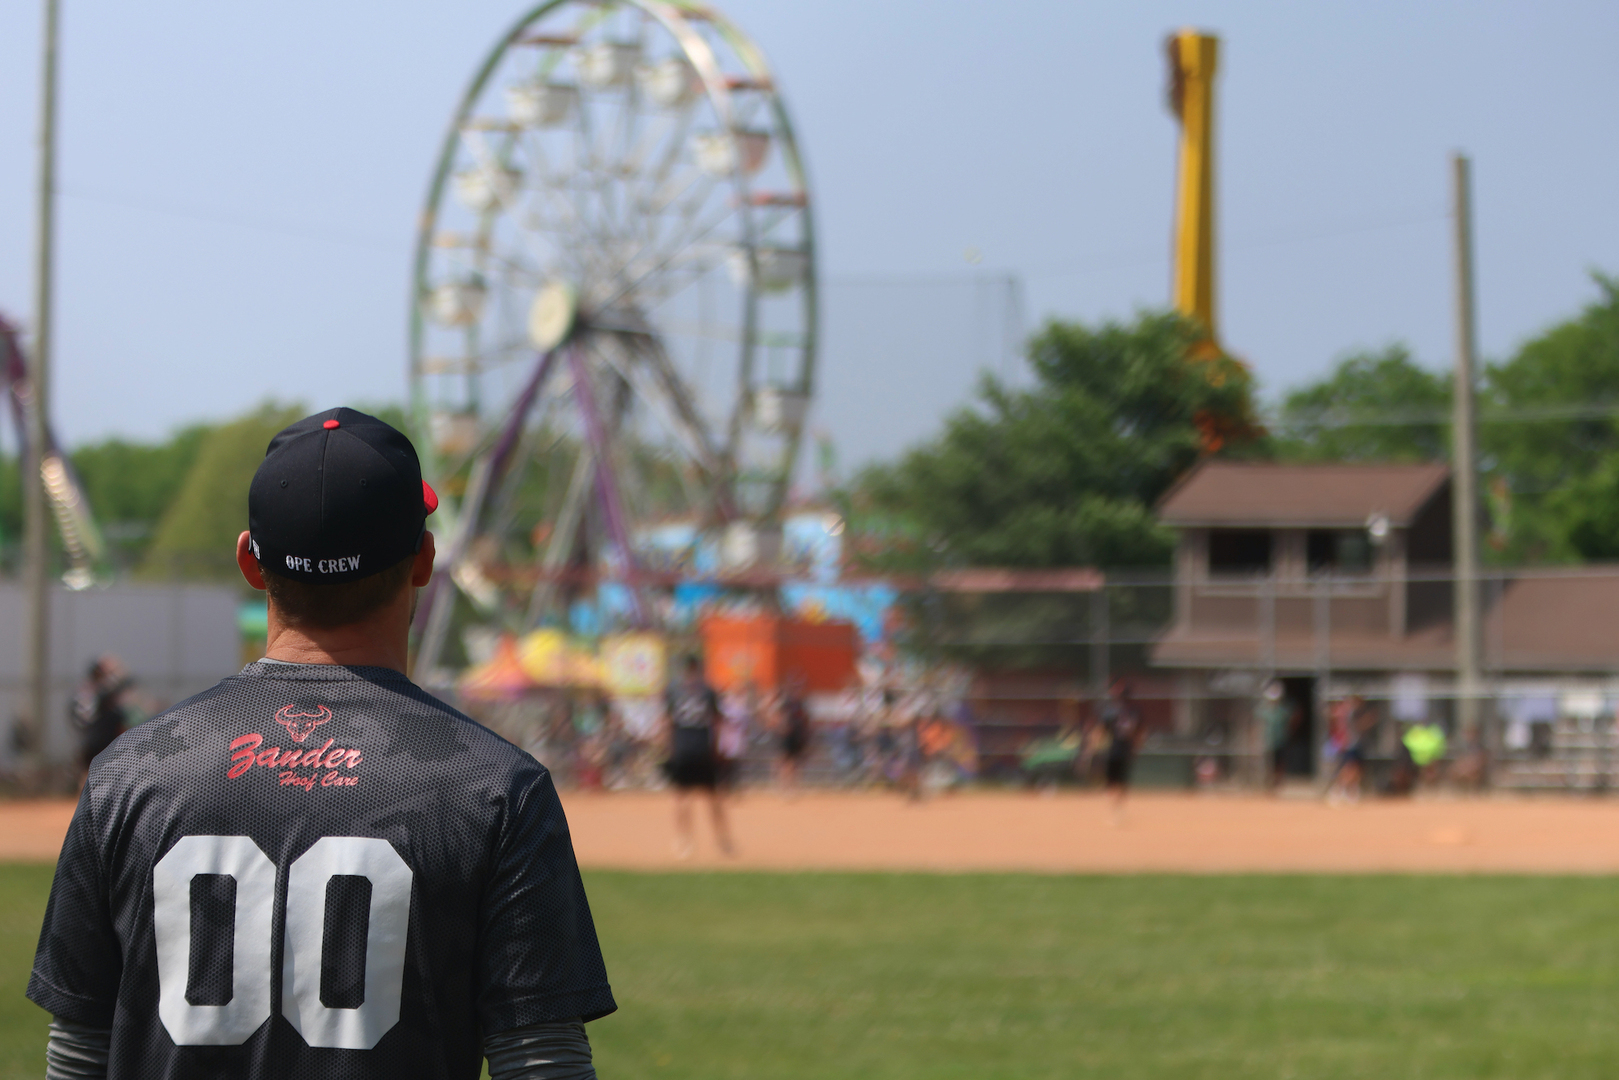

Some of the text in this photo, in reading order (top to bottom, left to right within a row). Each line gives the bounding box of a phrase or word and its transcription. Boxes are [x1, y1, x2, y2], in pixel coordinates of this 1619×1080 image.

[285, 554, 361, 573] OPE CREW
[227, 733, 363, 779] Zander
[279, 770, 359, 792] Hoof Care
[153, 835, 413, 1050] 00
